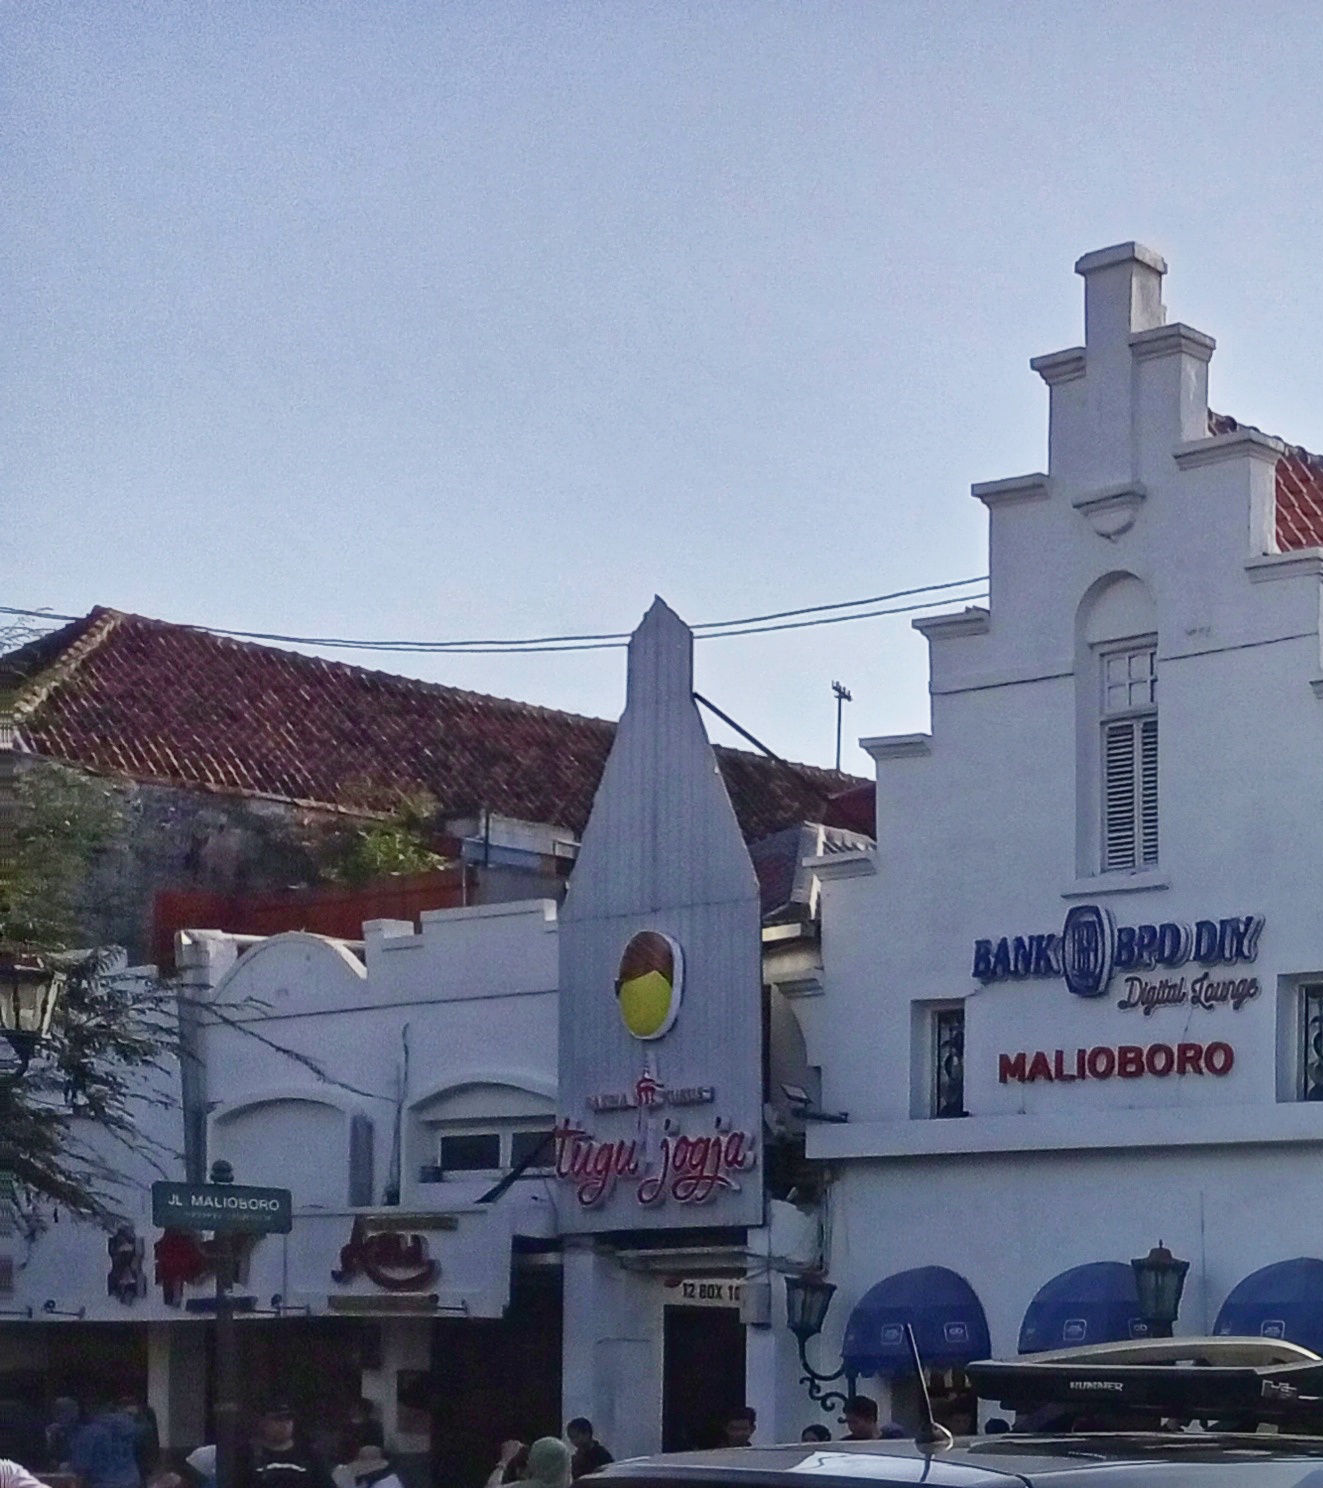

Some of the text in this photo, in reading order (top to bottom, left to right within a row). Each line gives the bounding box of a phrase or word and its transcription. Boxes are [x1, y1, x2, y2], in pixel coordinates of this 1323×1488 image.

[972, 915, 1262, 978] BANK BPD DIY
[1117, 971, 1261, 1015] Digital Lounge
[999, 1041, 1236, 1083] MALIOBORO
[191, 1195, 280, 1212] MALIOBORO
[682, 1282, 695, 1298] 12
[699, 1284, 722, 1299] BOX
